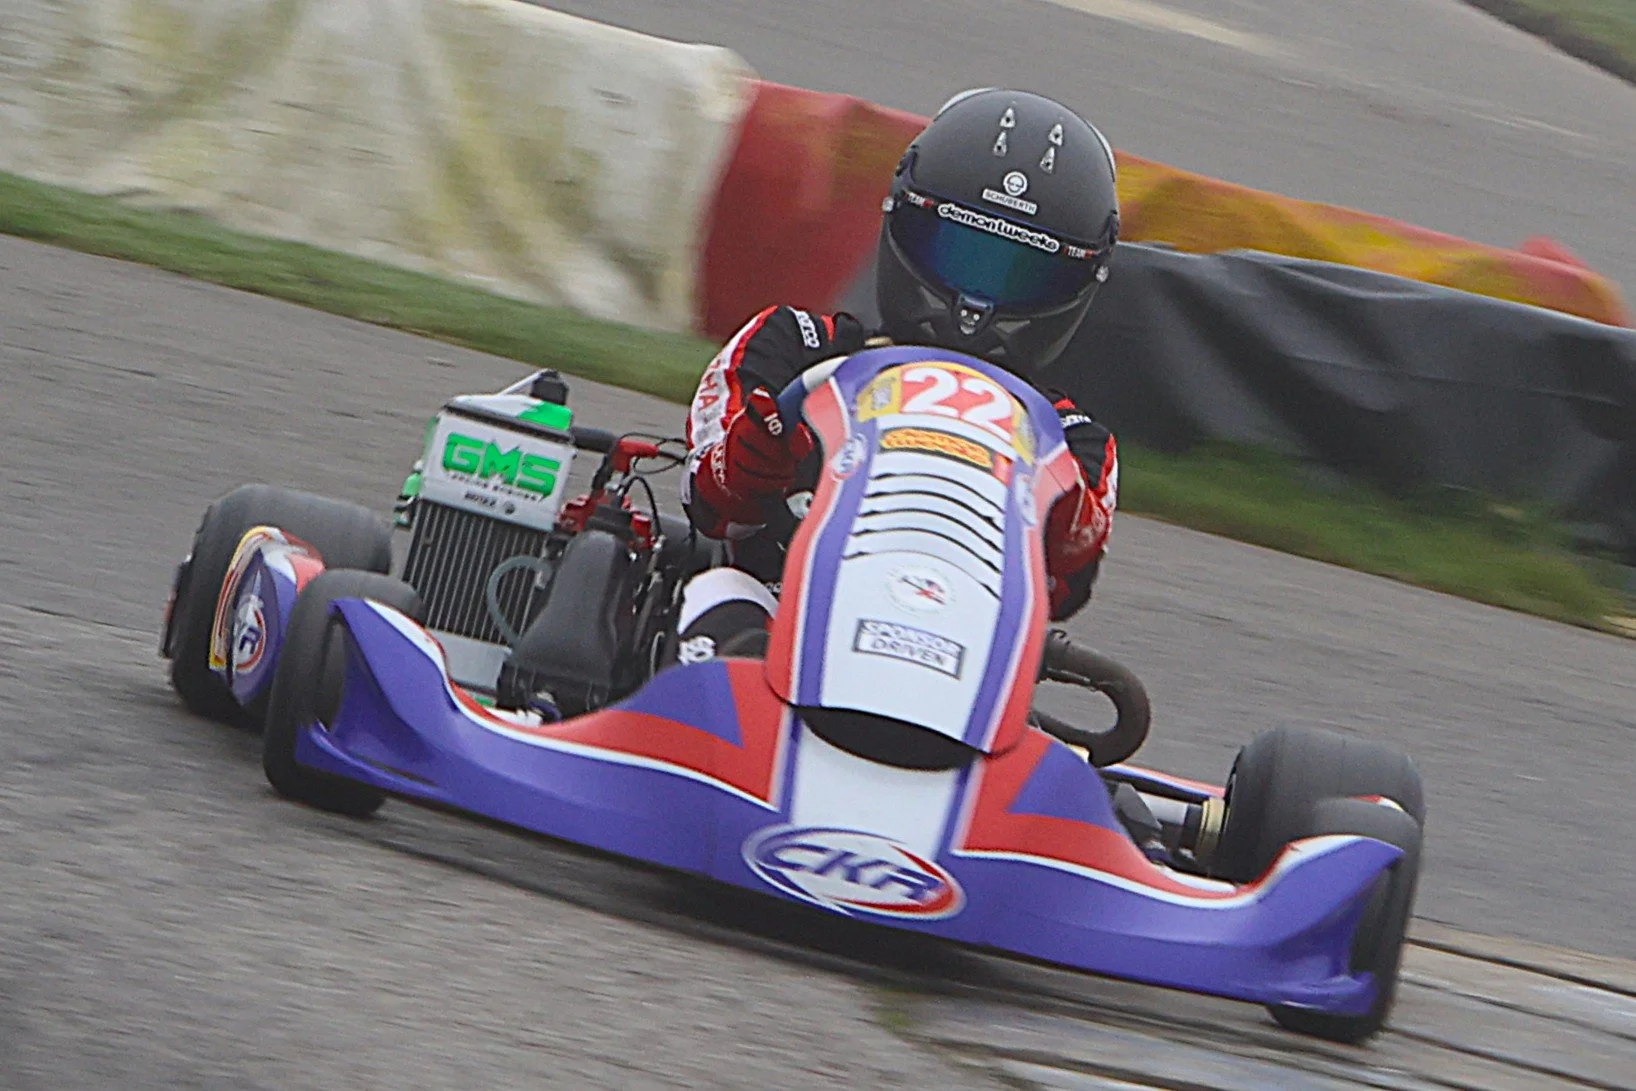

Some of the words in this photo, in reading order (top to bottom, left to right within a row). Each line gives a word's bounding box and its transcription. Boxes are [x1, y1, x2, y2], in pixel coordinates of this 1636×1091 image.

[984, 190, 1036, 213] SCHUBERTH
[902, 367, 1013, 443] 22
[443, 432, 561, 497] GMS
